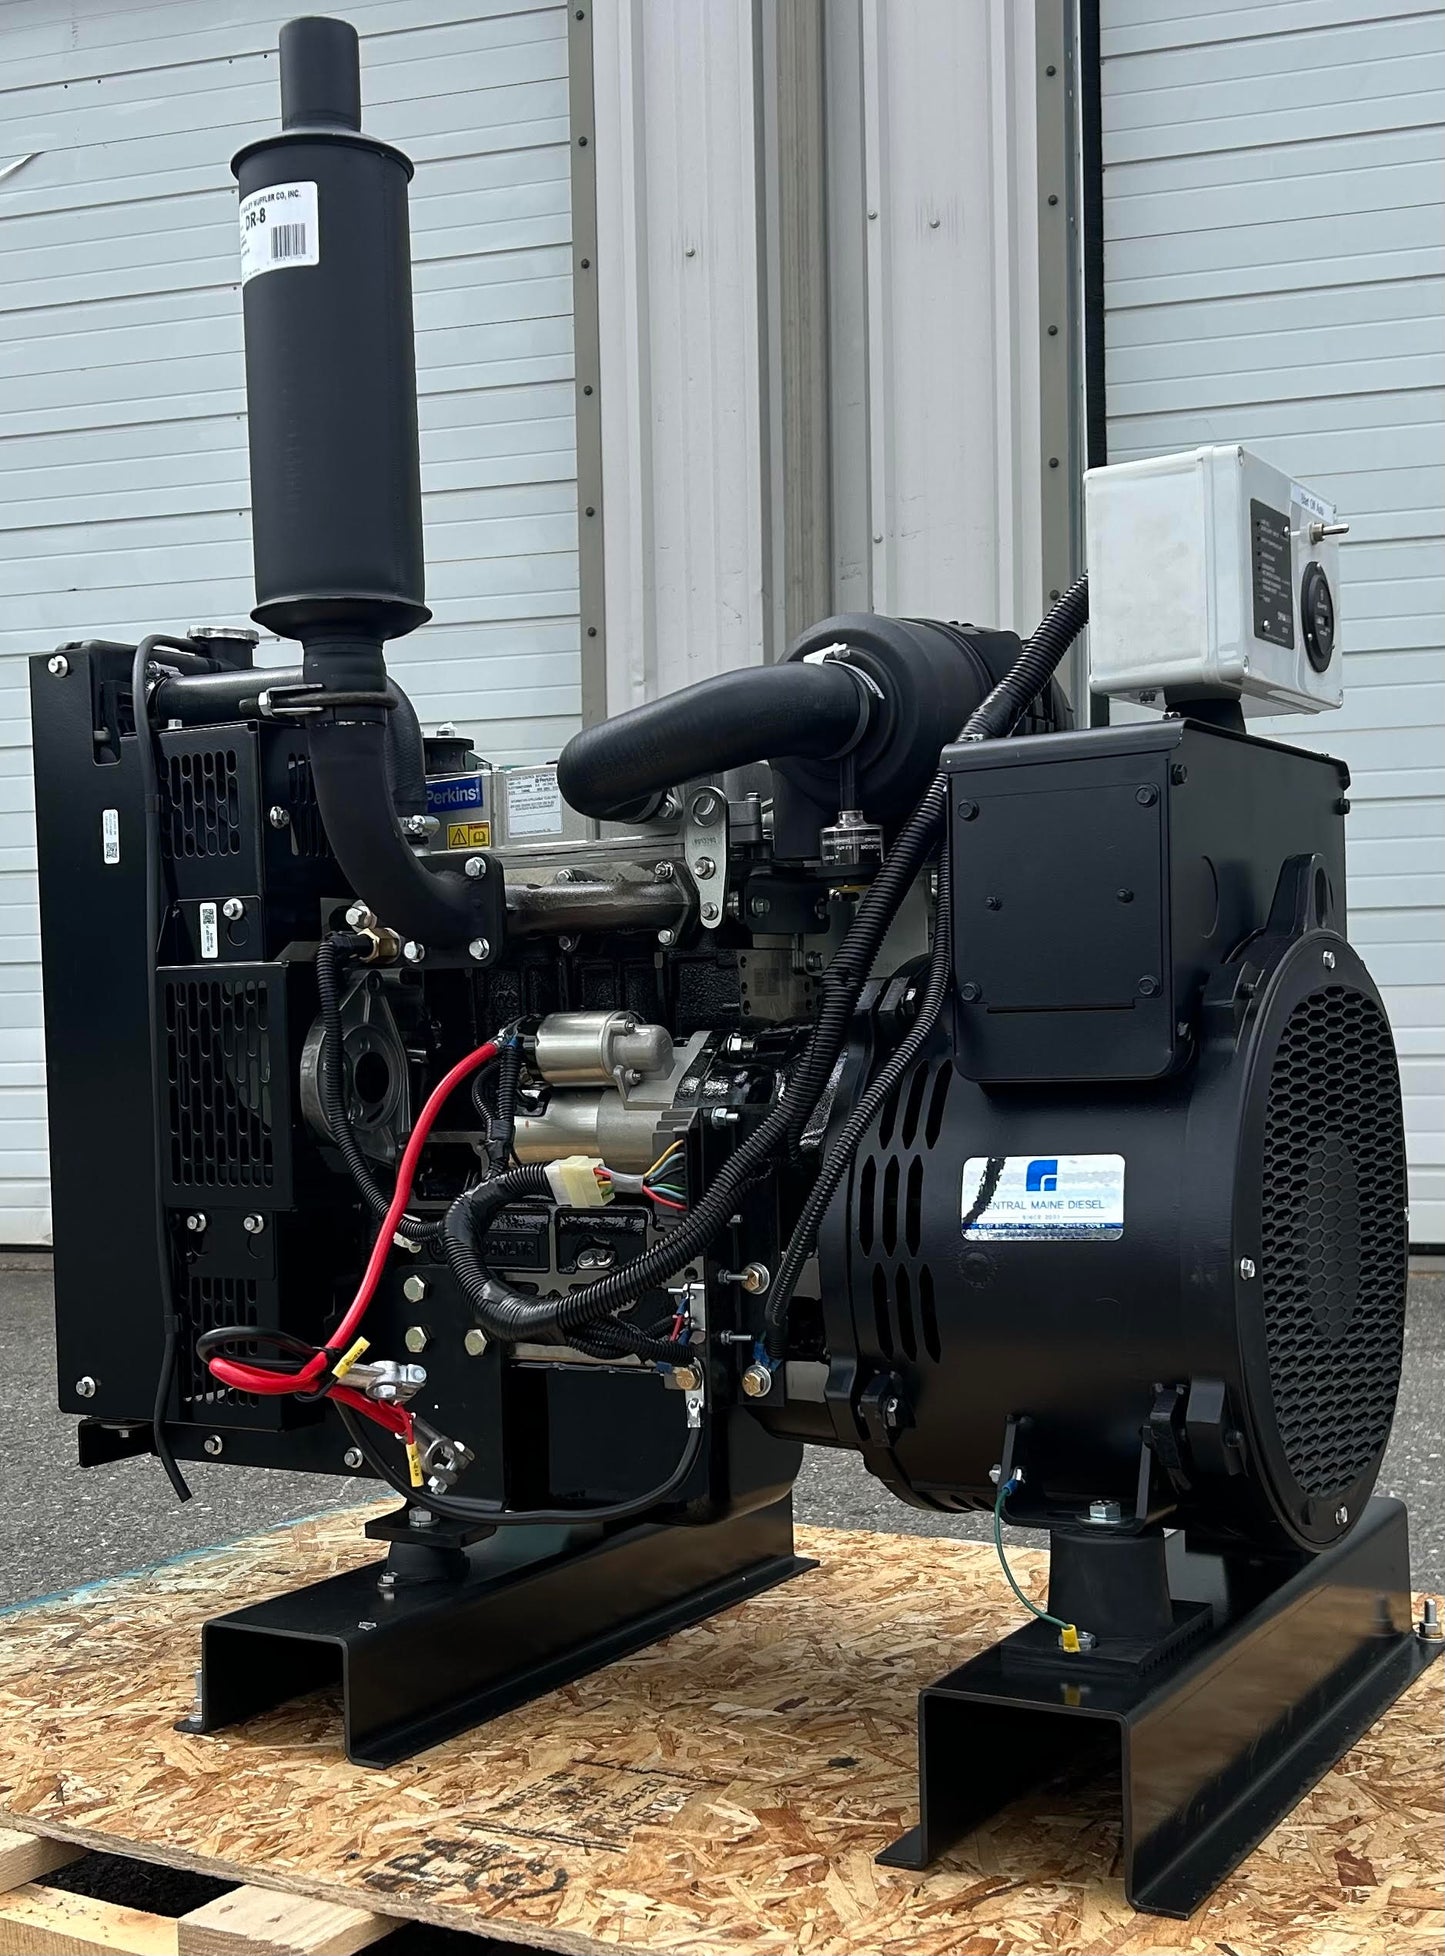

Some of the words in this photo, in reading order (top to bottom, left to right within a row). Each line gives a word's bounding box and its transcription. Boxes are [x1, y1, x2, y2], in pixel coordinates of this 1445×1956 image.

[287, 189, 302, 198] INC.
[245, 207, 266, 231] DR-8
[985, 1200, 1027, 1210] ENTRAL
[1031, 1200, 1065, 1210] MAINE
[1067, 1199, 1105, 1209] DIESEL
